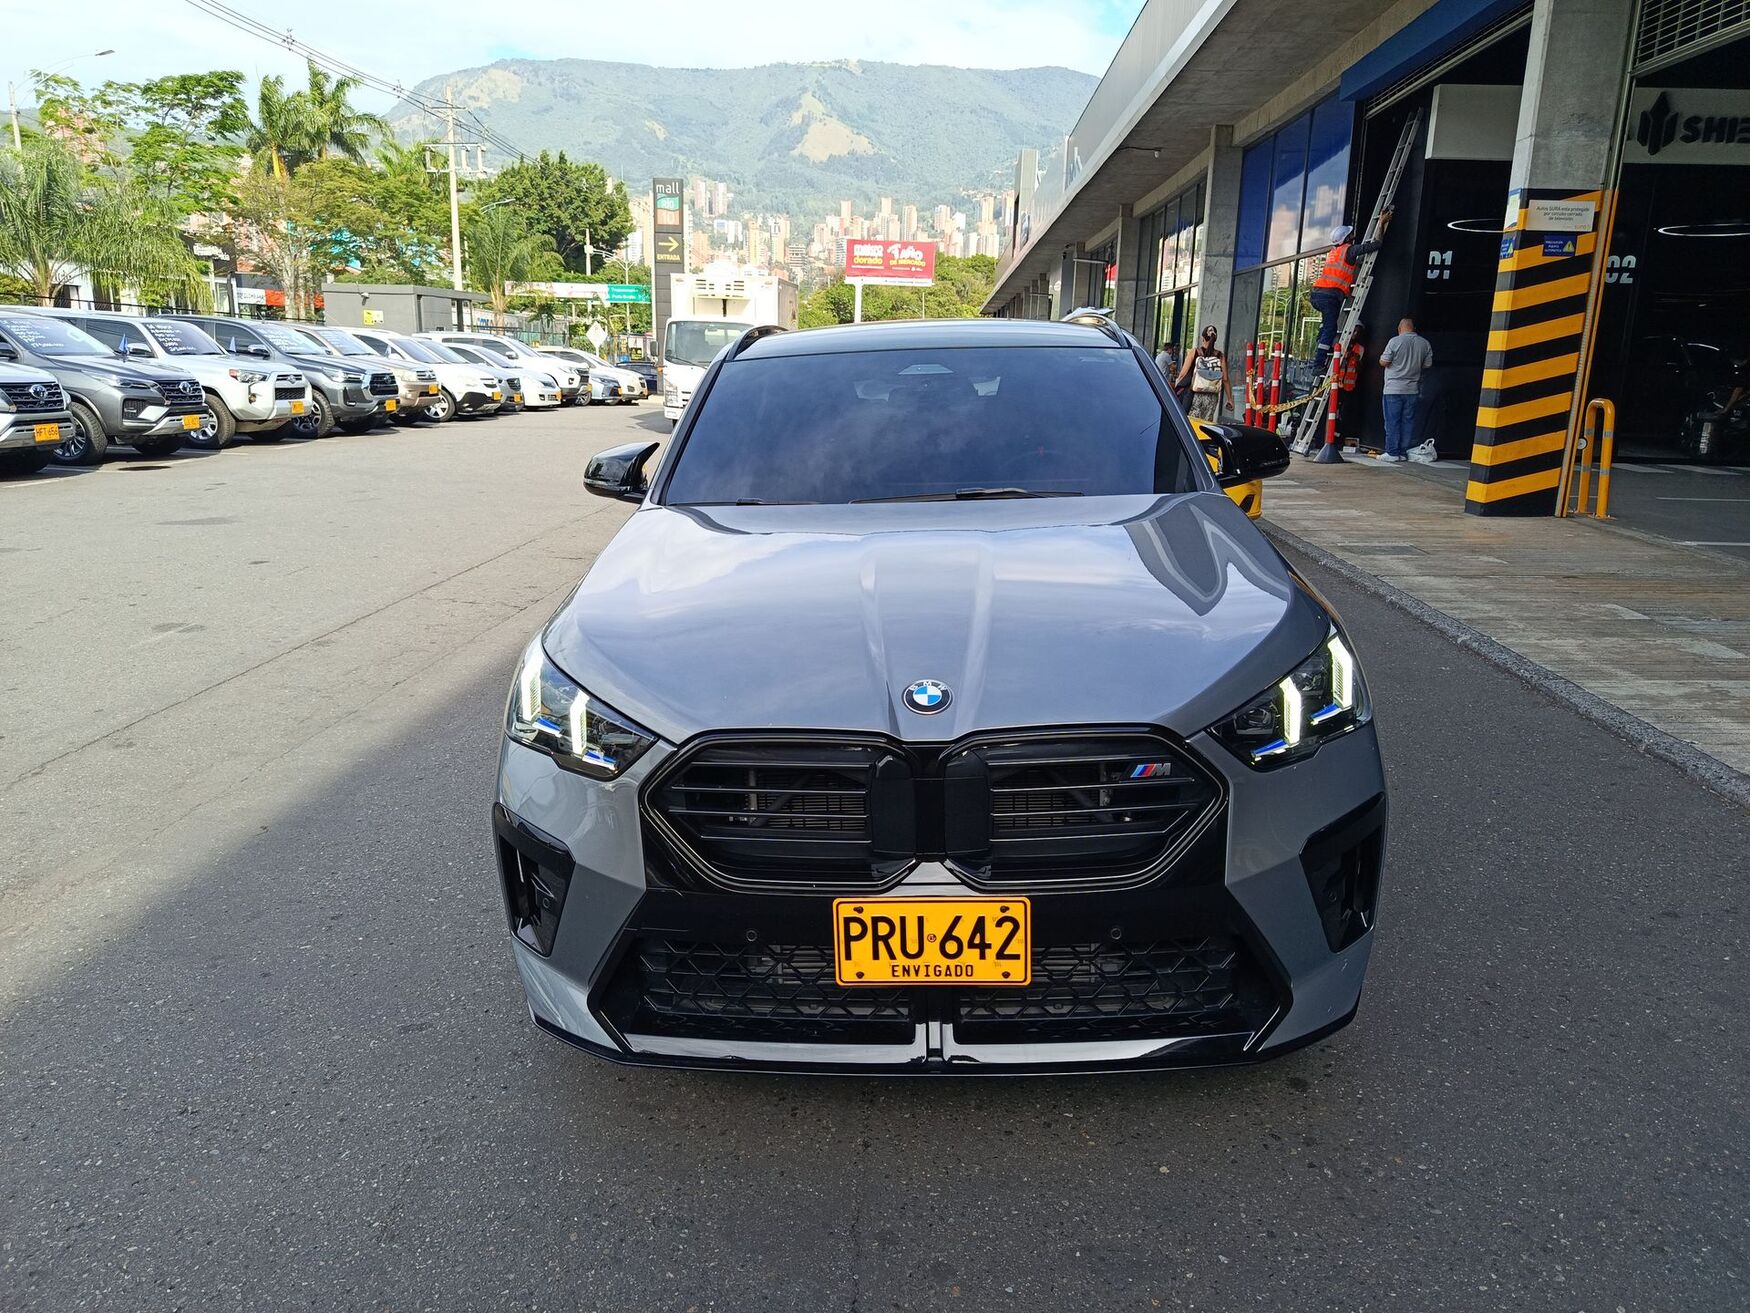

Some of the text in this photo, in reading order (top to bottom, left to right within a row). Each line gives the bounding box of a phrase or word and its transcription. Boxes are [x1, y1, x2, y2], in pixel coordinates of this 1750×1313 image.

[656, 182, 680, 194] mall
[656, 253, 681, 261] ENTRADA
[853, 255, 883, 264] dorado
[898, 259, 927, 267] MERCADO
[1426, 250, 1453, 280] 01
[843, 915, 1021, 961] PRU 642
[891, 964, 974, 978] ENVIGADO
